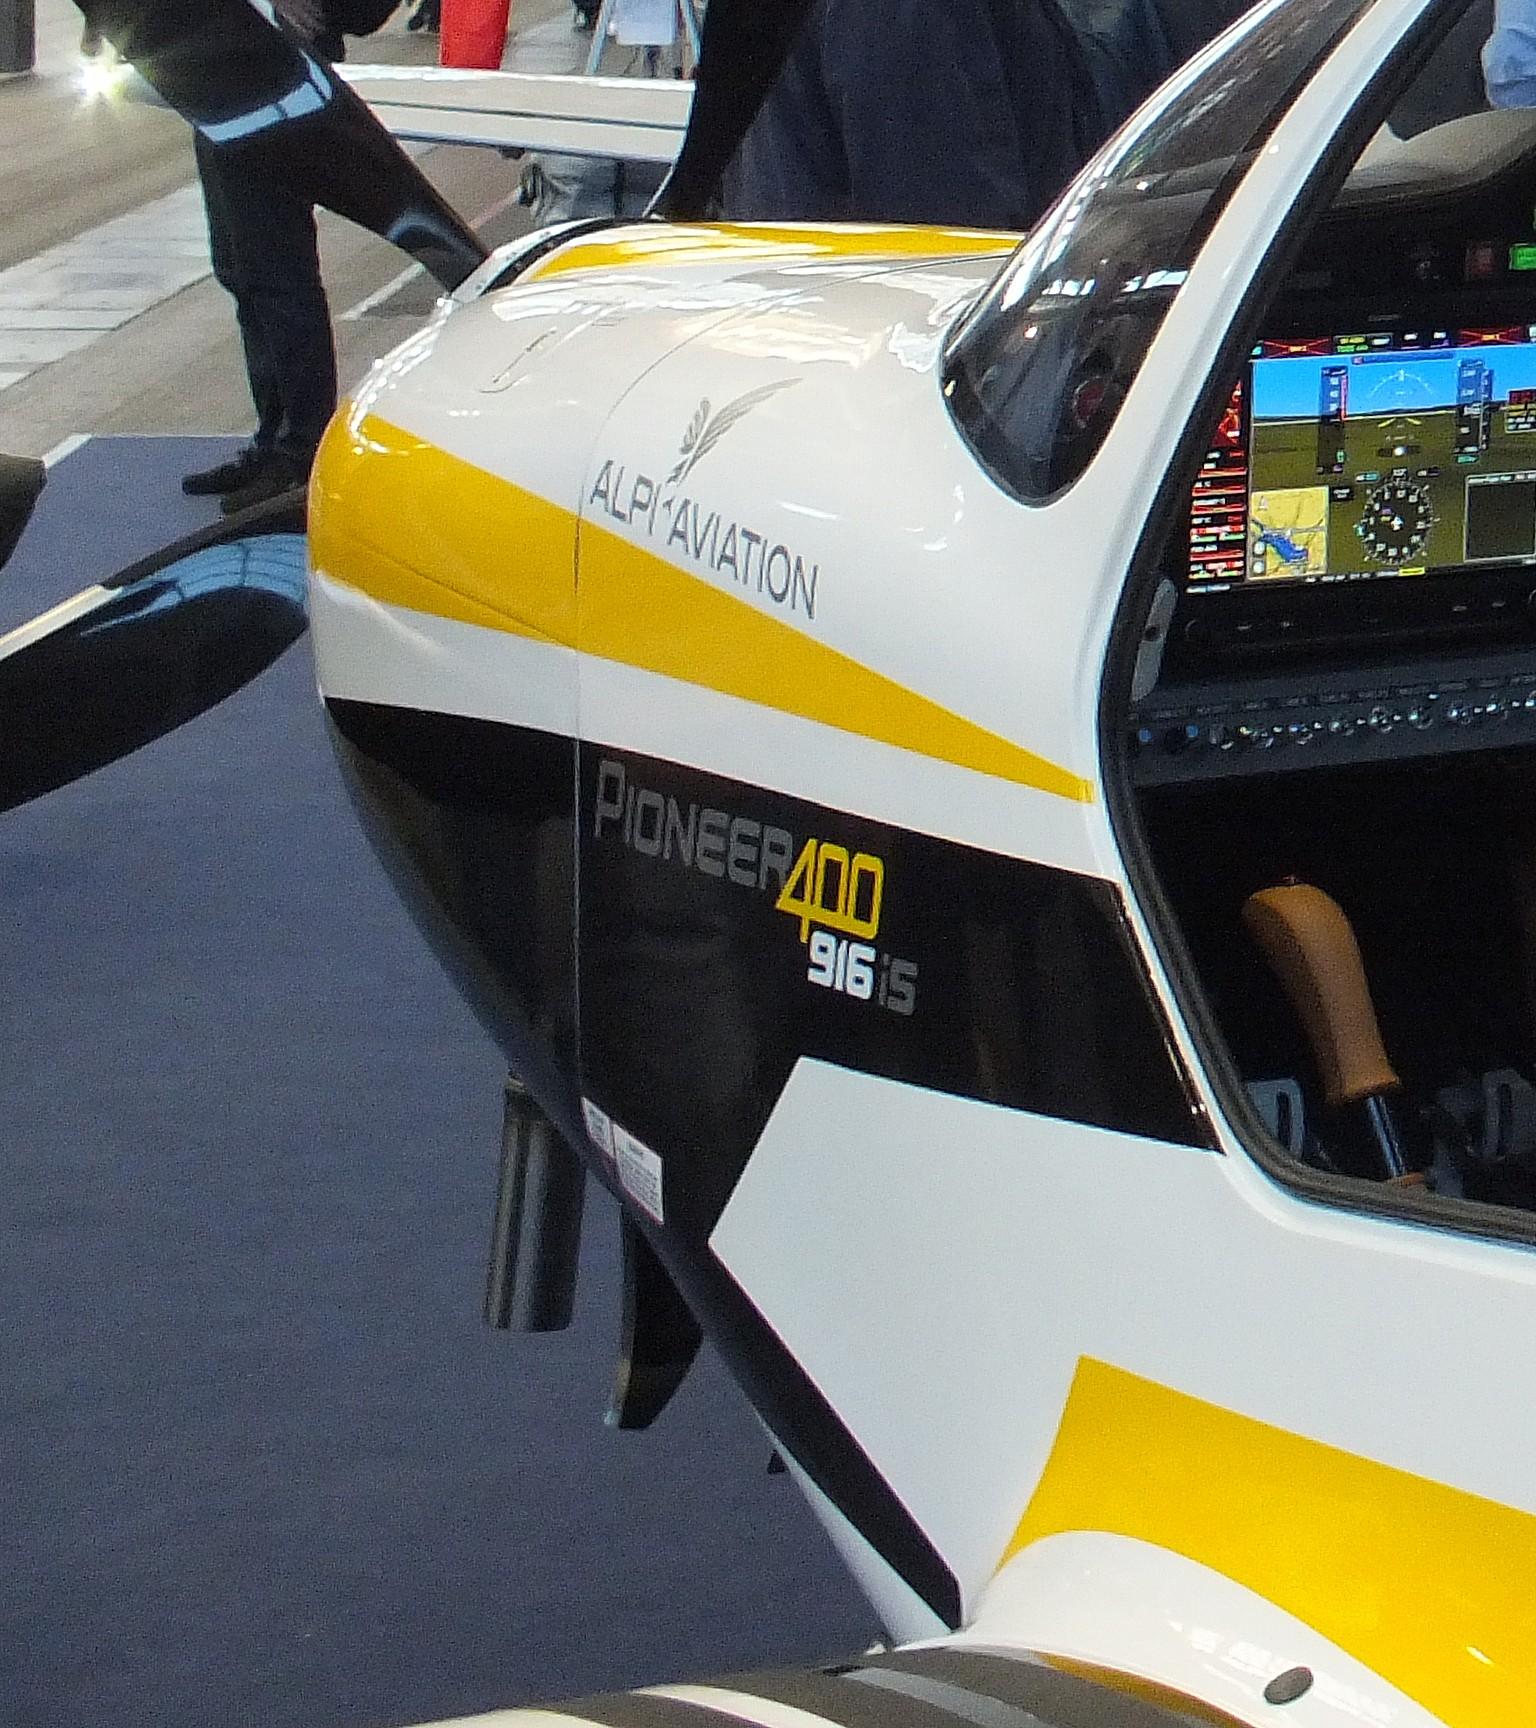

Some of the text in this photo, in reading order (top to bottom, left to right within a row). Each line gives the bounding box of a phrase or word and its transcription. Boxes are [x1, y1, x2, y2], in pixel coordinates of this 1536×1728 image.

[590, 459, 818, 620] ALPI AVIATION
[776, 838, 884, 944] 400
[807, 930, 876, 1000] 916
